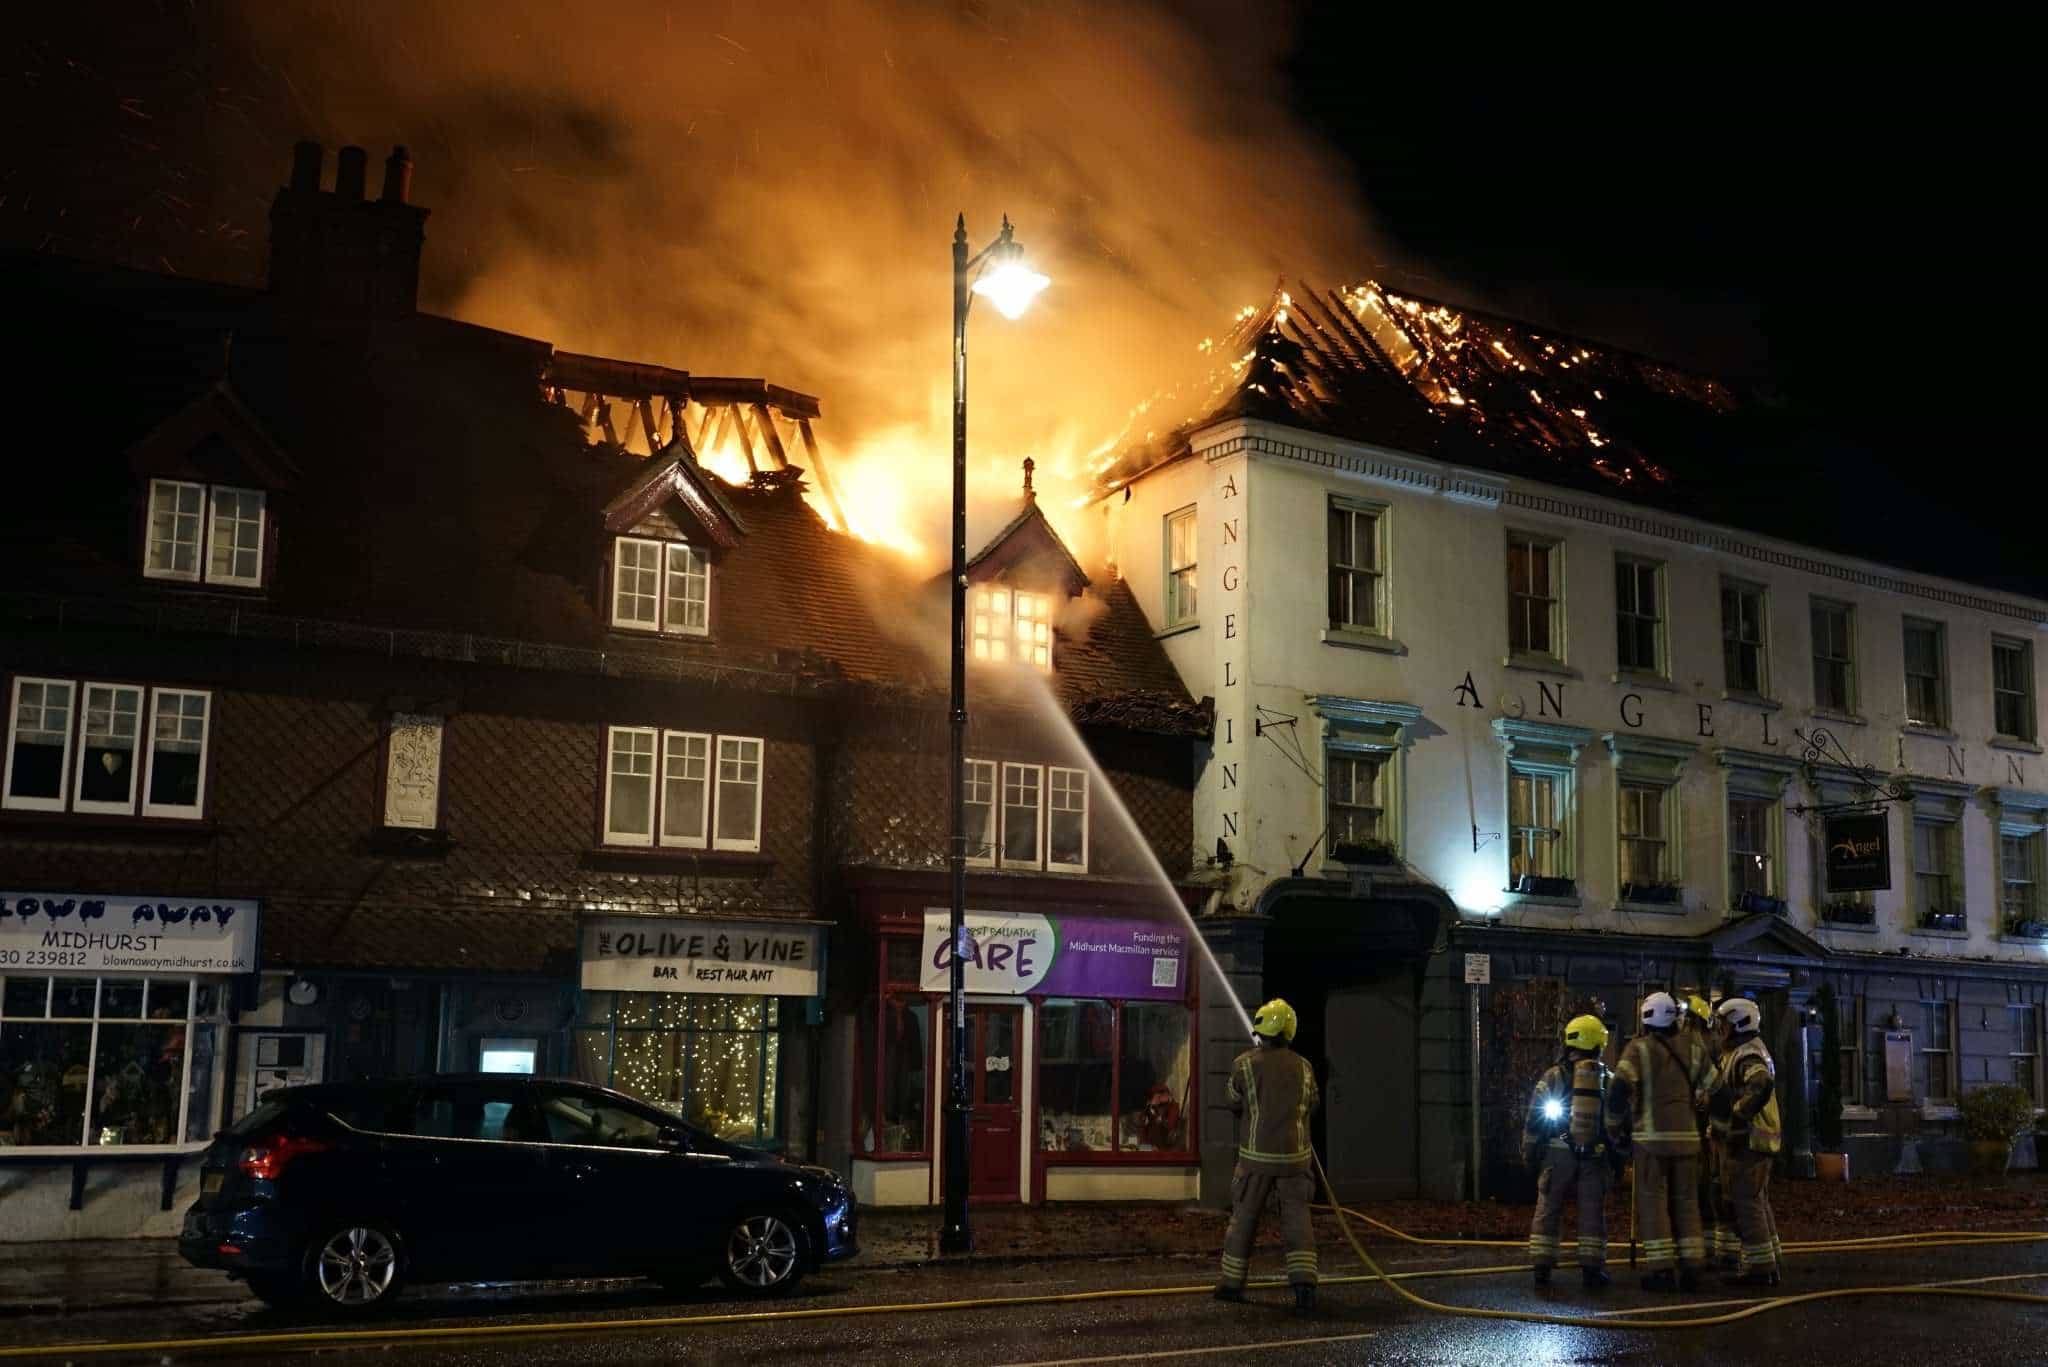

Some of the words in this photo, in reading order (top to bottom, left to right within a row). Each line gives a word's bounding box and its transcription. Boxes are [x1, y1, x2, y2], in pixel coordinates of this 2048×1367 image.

[1223, 475, 1239, 687] ANGEL
[1453, 671, 1778, 746] ANGEL
[1898, 736, 2025, 785] INN
[1222, 718, 1238, 838] INN
[132, 903, 235, 925] AWAY
[41, 930, 163, 951] MIDHURST
[599, 929, 611, 956] THE
[616, 932, 705, 958] OLIVE
[713, 934, 730, 962] &
[743, 938, 806, 960] VINE
[1069, 941, 1107, 953] Midhurst
[1108, 943, 1150, 955] Macmillan
[1151, 946, 1180, 956] service
[1133, 931, 1166, 945] Funding
[1167, 934, 1181, 944] the
[26, 951, 87, 966] 239812
[102, 954, 246, 969] blownawaymidhurst.co.uk
[933, 938, 1037, 977] CARE
[653, 966, 678, 980] BAR
[696, 969, 774, 982] RESTAURANT
